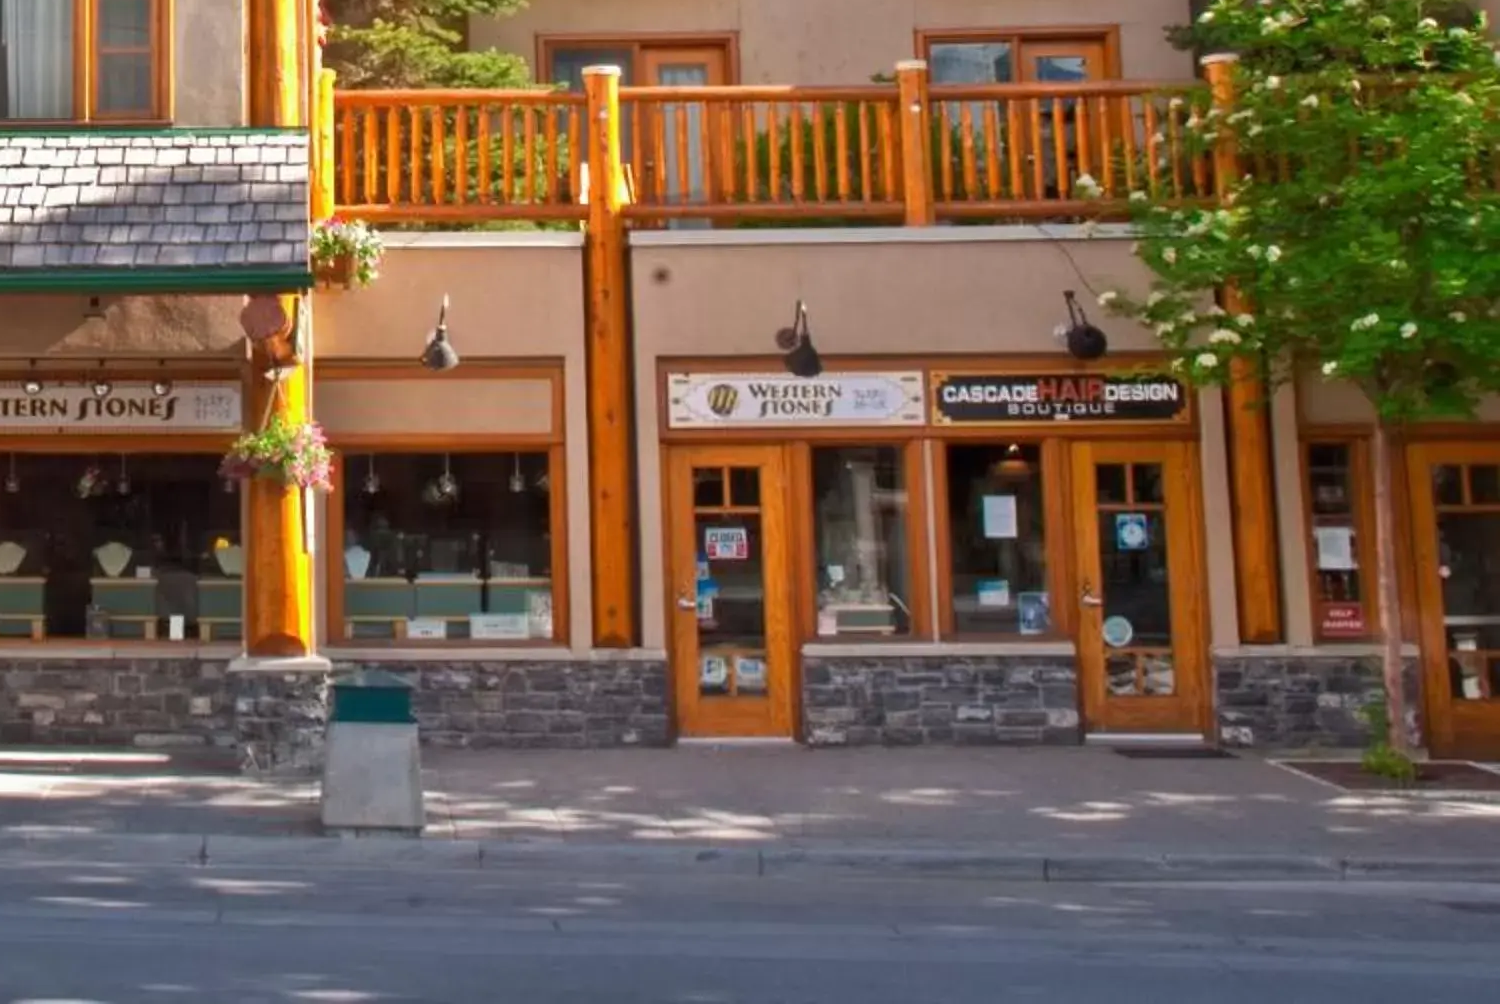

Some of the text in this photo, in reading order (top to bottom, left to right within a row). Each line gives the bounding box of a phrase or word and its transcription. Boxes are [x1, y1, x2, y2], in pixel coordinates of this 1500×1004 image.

[748, 383, 843, 399] WESTERN
[943, 385, 1038, 403] CASCADE
[1104, 383, 1178, 401] DESIGN
[75, 397, 180, 420] STONES
[1007, 402, 1116, 415] BOUTIQUE
